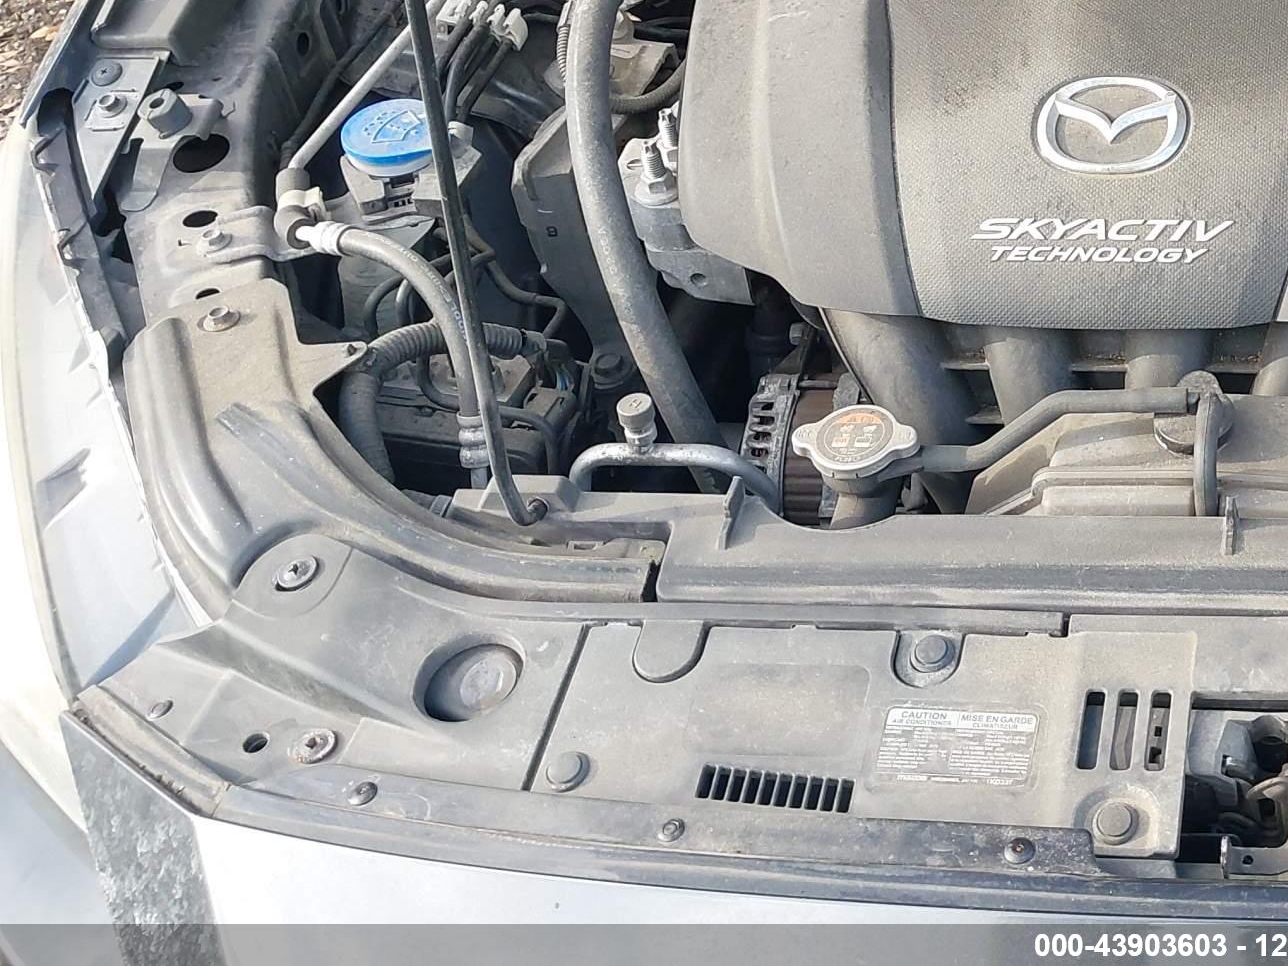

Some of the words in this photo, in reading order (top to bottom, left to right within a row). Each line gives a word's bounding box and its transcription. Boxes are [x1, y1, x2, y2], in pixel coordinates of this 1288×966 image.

[971, 217, 1235, 243] SKYACTIV
[990, 245, 1210, 264] TECHNOLOGY
[901, 711, 948, 720] CAUTION
[961, 714, 984, 722] MISE
[985, 715, 999, 723] EN
[1000, 716, 1034, 725] GARDE
